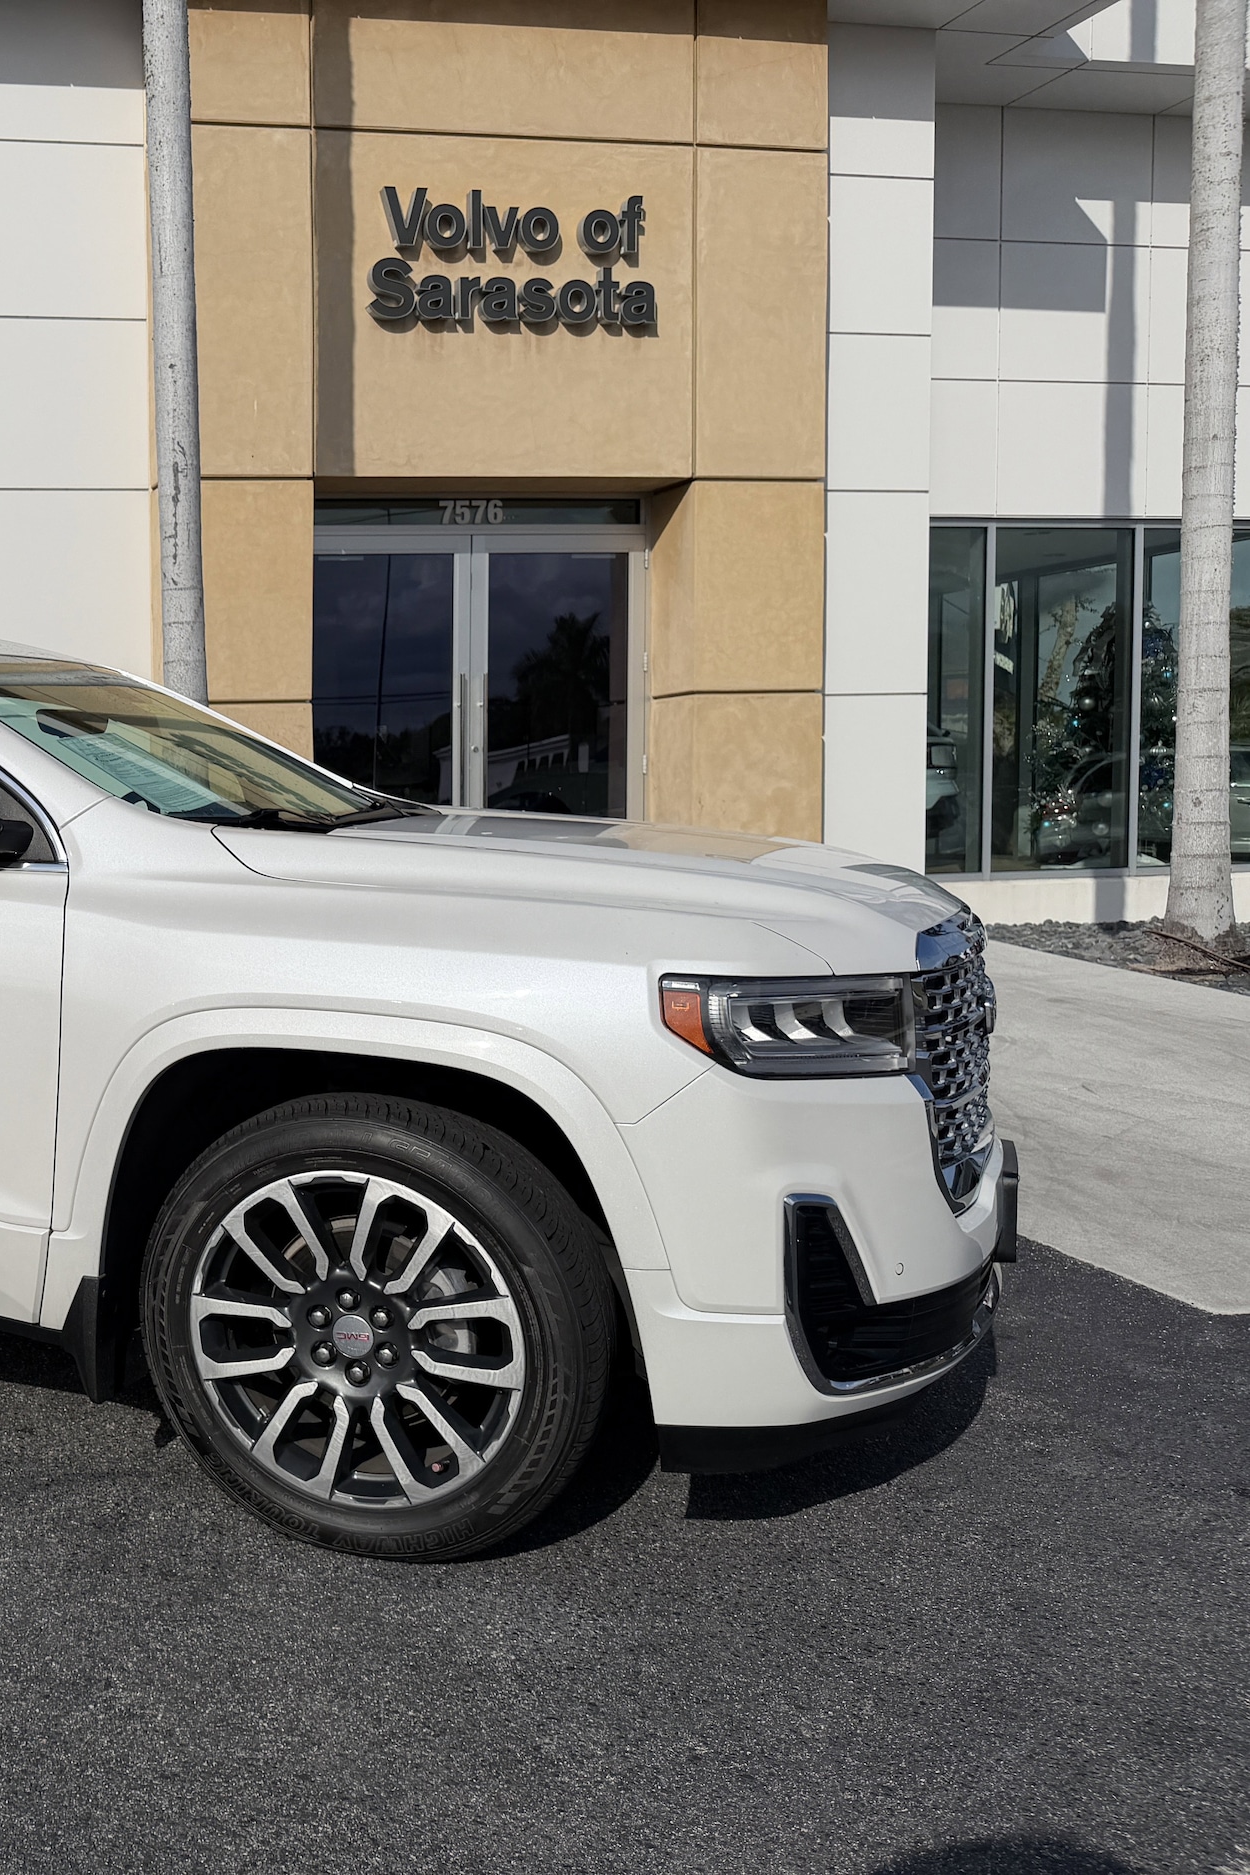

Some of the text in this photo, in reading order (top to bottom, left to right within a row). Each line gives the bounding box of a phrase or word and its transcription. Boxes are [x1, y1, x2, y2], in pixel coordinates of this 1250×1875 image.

[380, 186, 644, 256] Volvo of
[366, 257, 657, 326] Sarasota
[439, 500, 503, 524] 7576
[204, 1452, 320, 1538] TOURING
[333, 1519, 476, 1553] HIGHWAY
